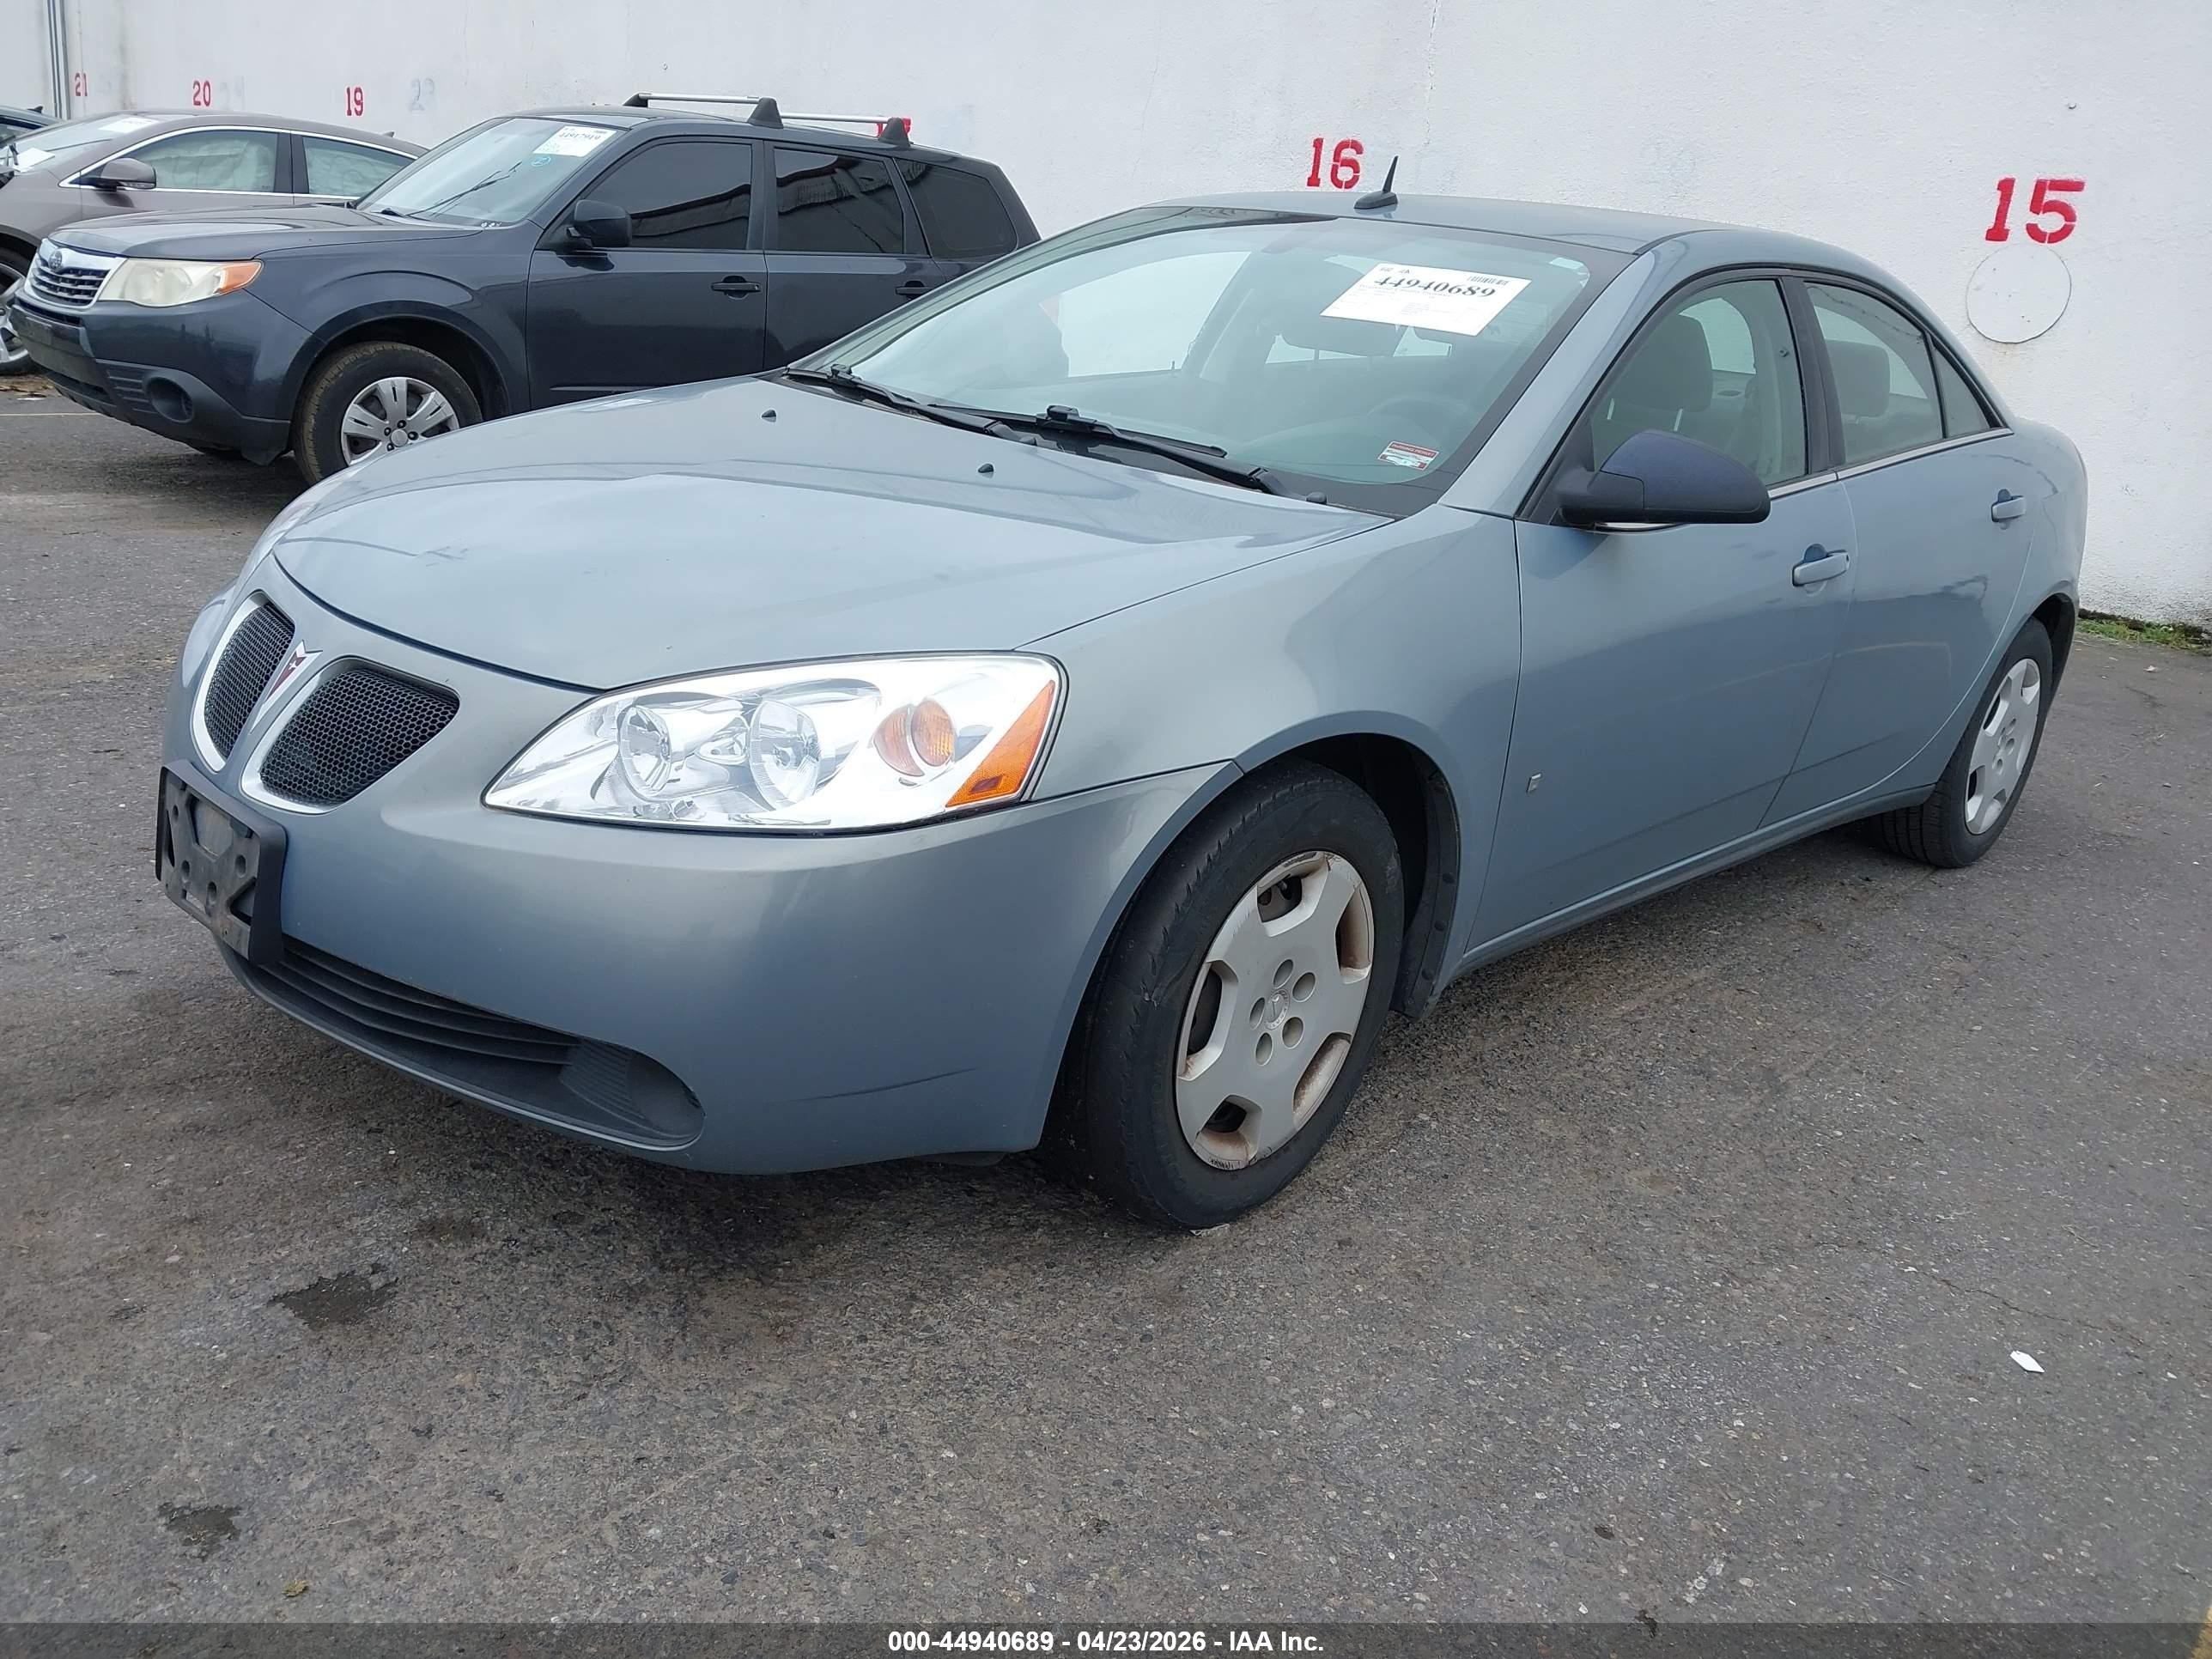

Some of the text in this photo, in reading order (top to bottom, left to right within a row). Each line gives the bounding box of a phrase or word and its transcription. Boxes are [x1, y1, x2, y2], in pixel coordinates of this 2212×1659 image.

[74, 72, 88, 97] 21
[191, 80, 212, 107] 20
[346, 86, 364, 117] 19
[1306, 137, 1364, 190] 16
[1984, 177, 2086, 245] 15
[1374, 276, 1497, 297] 44940689
